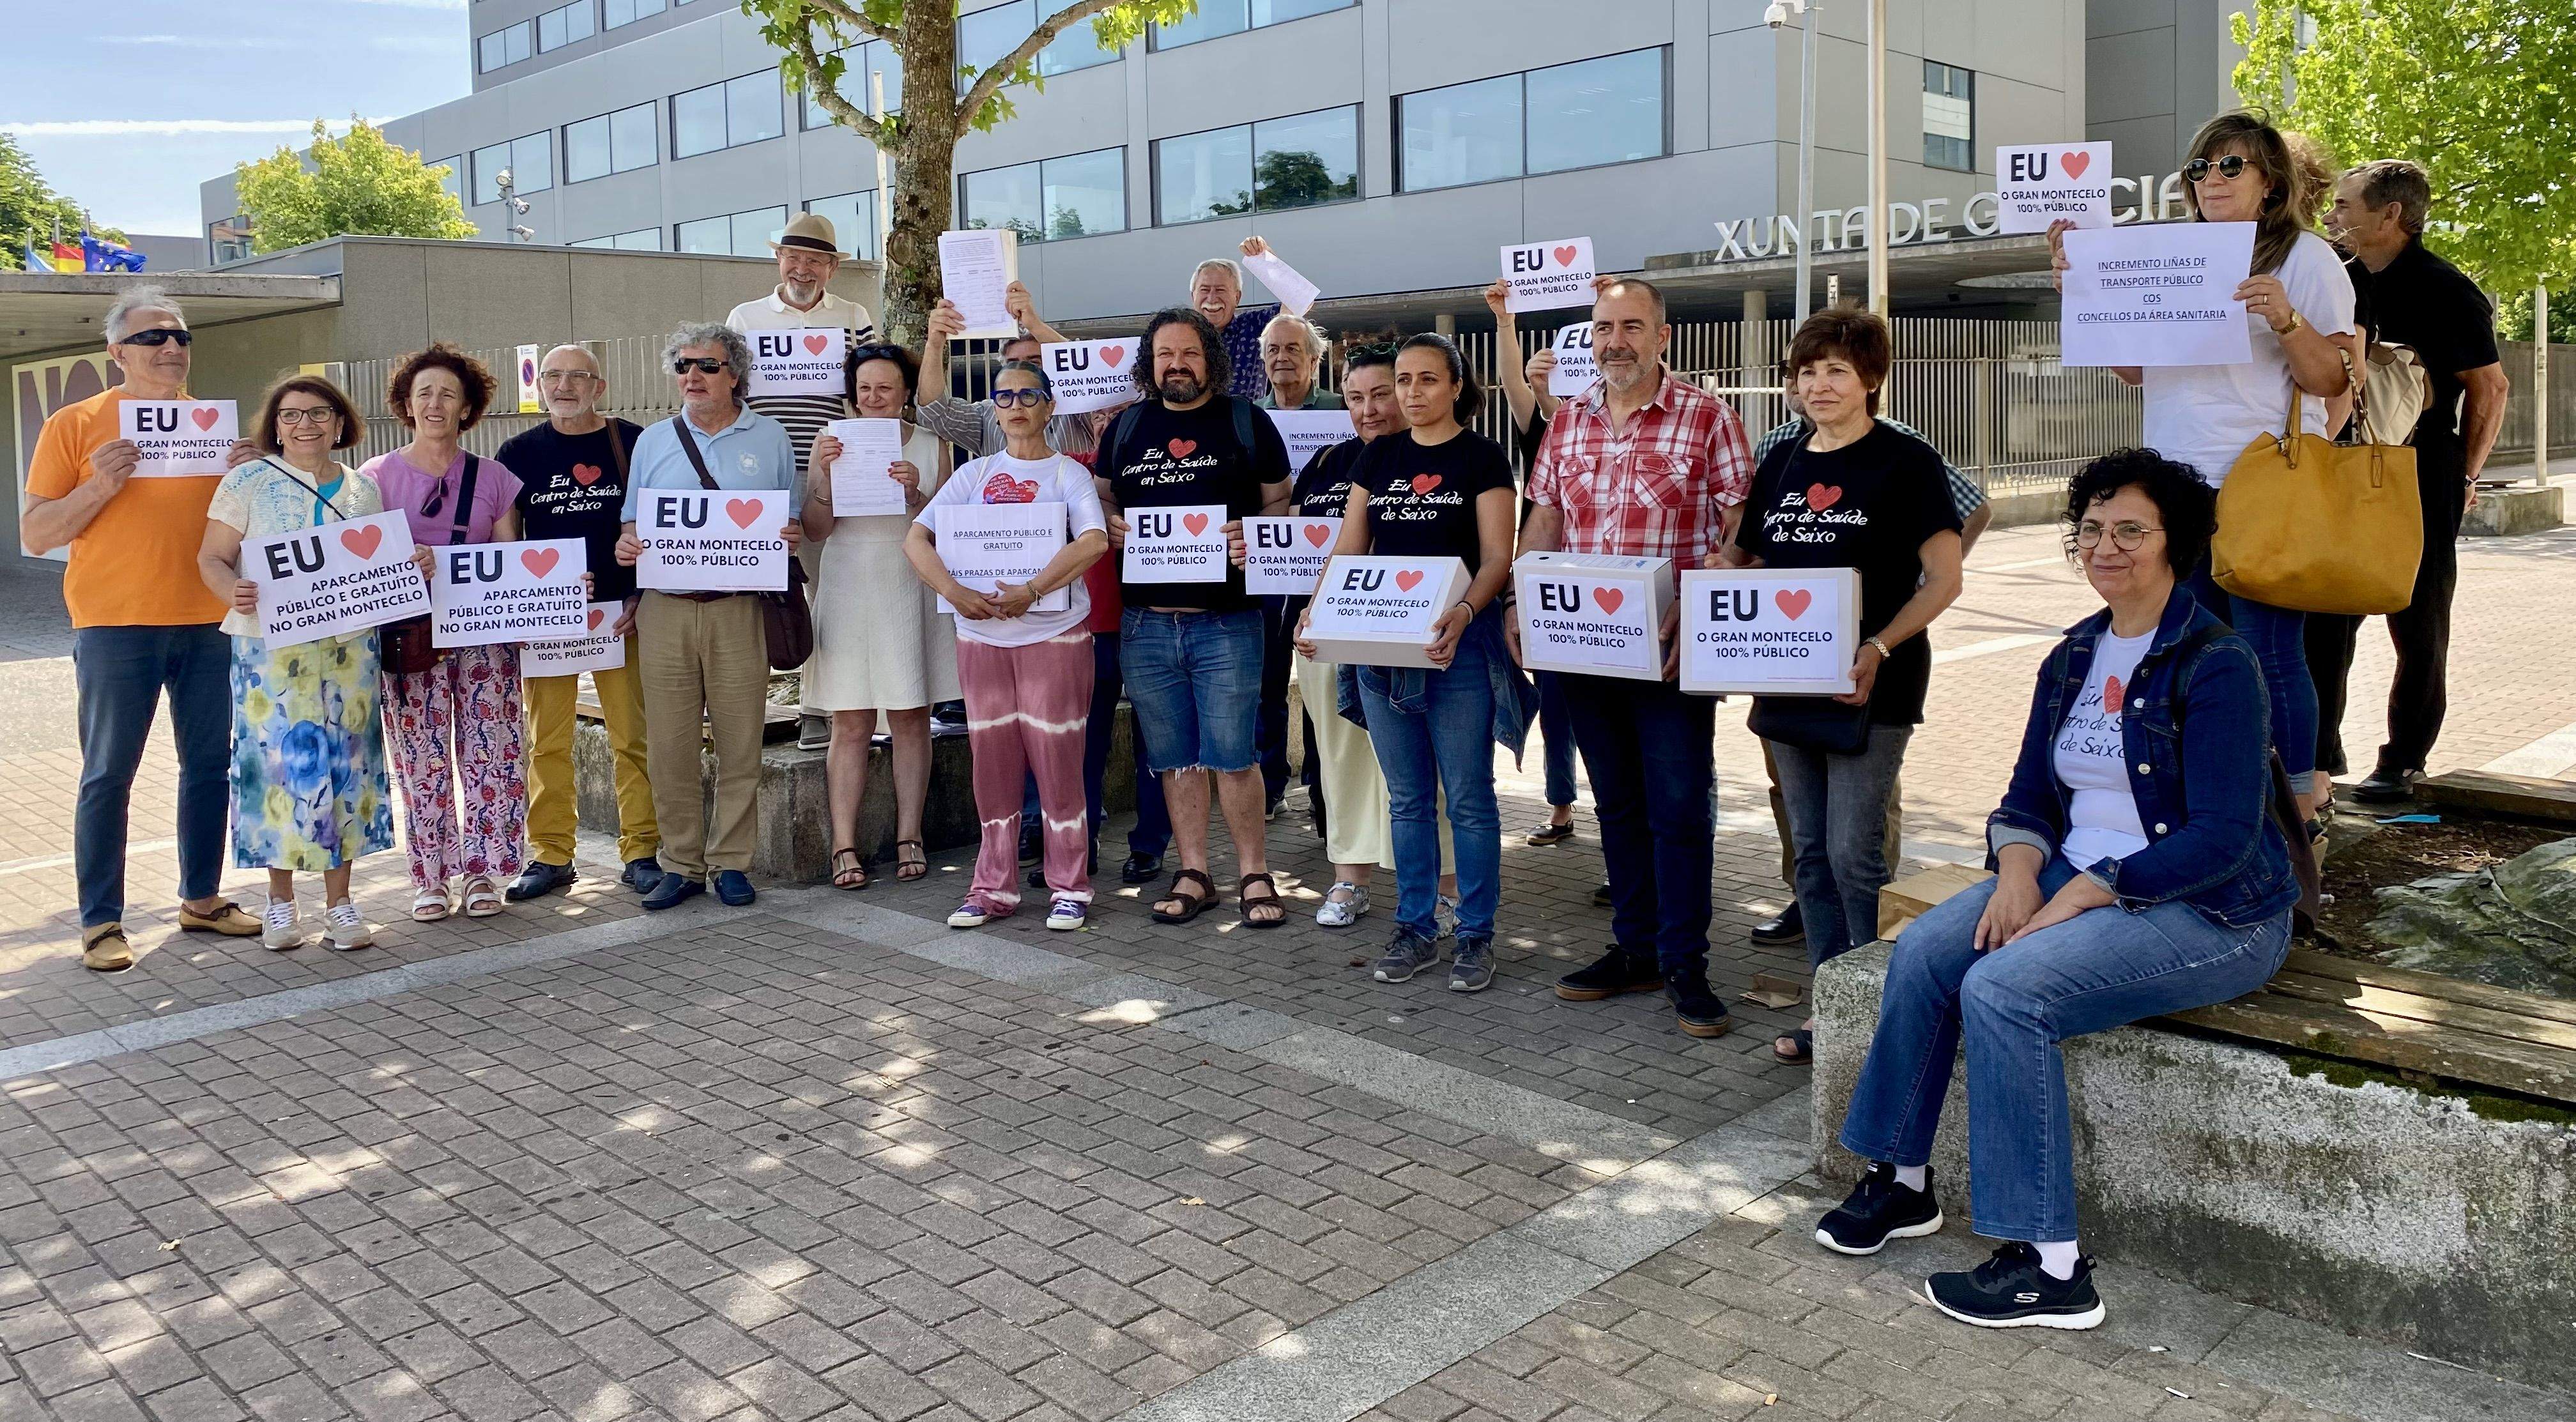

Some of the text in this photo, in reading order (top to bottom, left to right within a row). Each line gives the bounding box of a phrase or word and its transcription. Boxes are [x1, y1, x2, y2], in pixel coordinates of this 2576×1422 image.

[2011, 153, 2047, 181] EU
[2002, 189, 2105, 200] O GRAN MONTECELO
[2018, 201, 2087, 213] 100% PÚBLICO
[1713, 205, 1869, 262] XUNTA
[1887, 197, 1951, 244] DE
[1513, 248, 1543, 272] EU
[2098, 256, 2207, 270] INCREMENTO LIÑAS DE
[1515, 277, 1538, 286] GRAN
[1541, 272, 1591, 284] MONTECELO
[2101, 274, 2203, 287] TRANSPORTE PÚBLICO
[1519, 284, 1578, 296] 100% PÚBLICO
[2143, 294, 2161, 303] COS
[2078, 309, 2227, 322] CONCELLOS DA ÁREA SANITARIA
[1562, 328, 1593, 349] EU
[759, 335, 792, 357] EU
[789, 362, 843, 371] MONTECELO
[1055, 348, 1089, 372] EU
[790, 372, 828, 380] PÚBLICO
[1057, 378, 1083, 387] GRAN
[1086, 374, 1135, 385] MONTECEL
[1062, 385, 1126, 397] 100% PÚBLICO
[137, 408, 178, 432] EU
[141, 448, 217, 460] 100% PÚBLICO
[1143, 448, 1164, 460] Eu
[1122, 455, 1218, 477] Centro de Saúde
[550, 475, 570, 488] Eu
[1141, 471, 1195, 486] en Seixo
[1388, 479, 1411, 492] Eu
[1329, 482, 1351, 491] Eu
[530, 484, 622, 505] Centro de Saúde
[1304, 494, 1344, 506] Centro
[1404, 493, 1420, 504] de
[1422, 491, 1463, 505] Saúde
[1781, 493, 1806, 507] Eu
[552, 499, 602, 514] en Seixo
[656, 497, 709, 529] EU
[1326, 508, 1339, 517] en
[1381, 507, 1438, 521] de Seixo
[1798, 509, 1816, 523] de
[1818, 509, 1867, 525] Saúde
[953, 530, 1011, 539] APARCAMENTO
[1013, 528, 1046, 537] PÚBLICO
[1138, 514, 1172, 539] EU
[1772, 525, 1836, 542] de Seixo
[1257, 524, 1292, 549] EU
[642, 539, 783, 551] O GRAN MONTECELO
[1138, 546, 1164, 554] GRAN
[1167, 544, 1223, 553] MONTECELO
[264, 535, 325, 580] EU
[661, 552, 759, 566] 100% PÚBLICO
[1141, 554, 1207, 565] 100% PÚBLICO
[1249, 556, 1257, 564] O
[1259, 556, 1287, 565] GRAN
[450, 550, 503, 585] EU
[1263, 565, 1322, 576] 100% PÚBLIC
[311, 560, 415, 593] APARCAMENTO
[1342, 569, 1385, 591] EU
[277, 576, 418, 616] PÚBLICO E GRATUÍTO
[483, 585, 581, 601] APARCAMENTO
[1540, 583, 1580, 613] EU
[449, 598, 582, 618] PÚBLICO E GRATUÍTO
[1368, 599, 1430, 608] MONTECELO
[1710, 590, 1758, 621] EU
[270, 621, 292, 634] NO
[296, 610, 336, 628] GRAN
[340, 590, 422, 618] MONTECELO
[1337, 607, 1408, 618] 100% PÚBLICO
[440, 615, 583, 634] NO GRAN MONTECELO
[1533, 620, 1643, 636] O GRAN MONTECELO
[533, 641, 560, 650] GRAN
[563, 636, 620, 649] MONTECELO
[1549, 634, 1625, 648] 100% PÚBLICO
[1698, 632, 1832, 642] O GRAN MONTECELO
[537, 647, 604, 661] 100% PÚBLICO
[1716, 645, 1809, 657] 100% PÚBLICO
[2090, 712, 2107, 731] de
[2060, 733, 2077, 752] de
